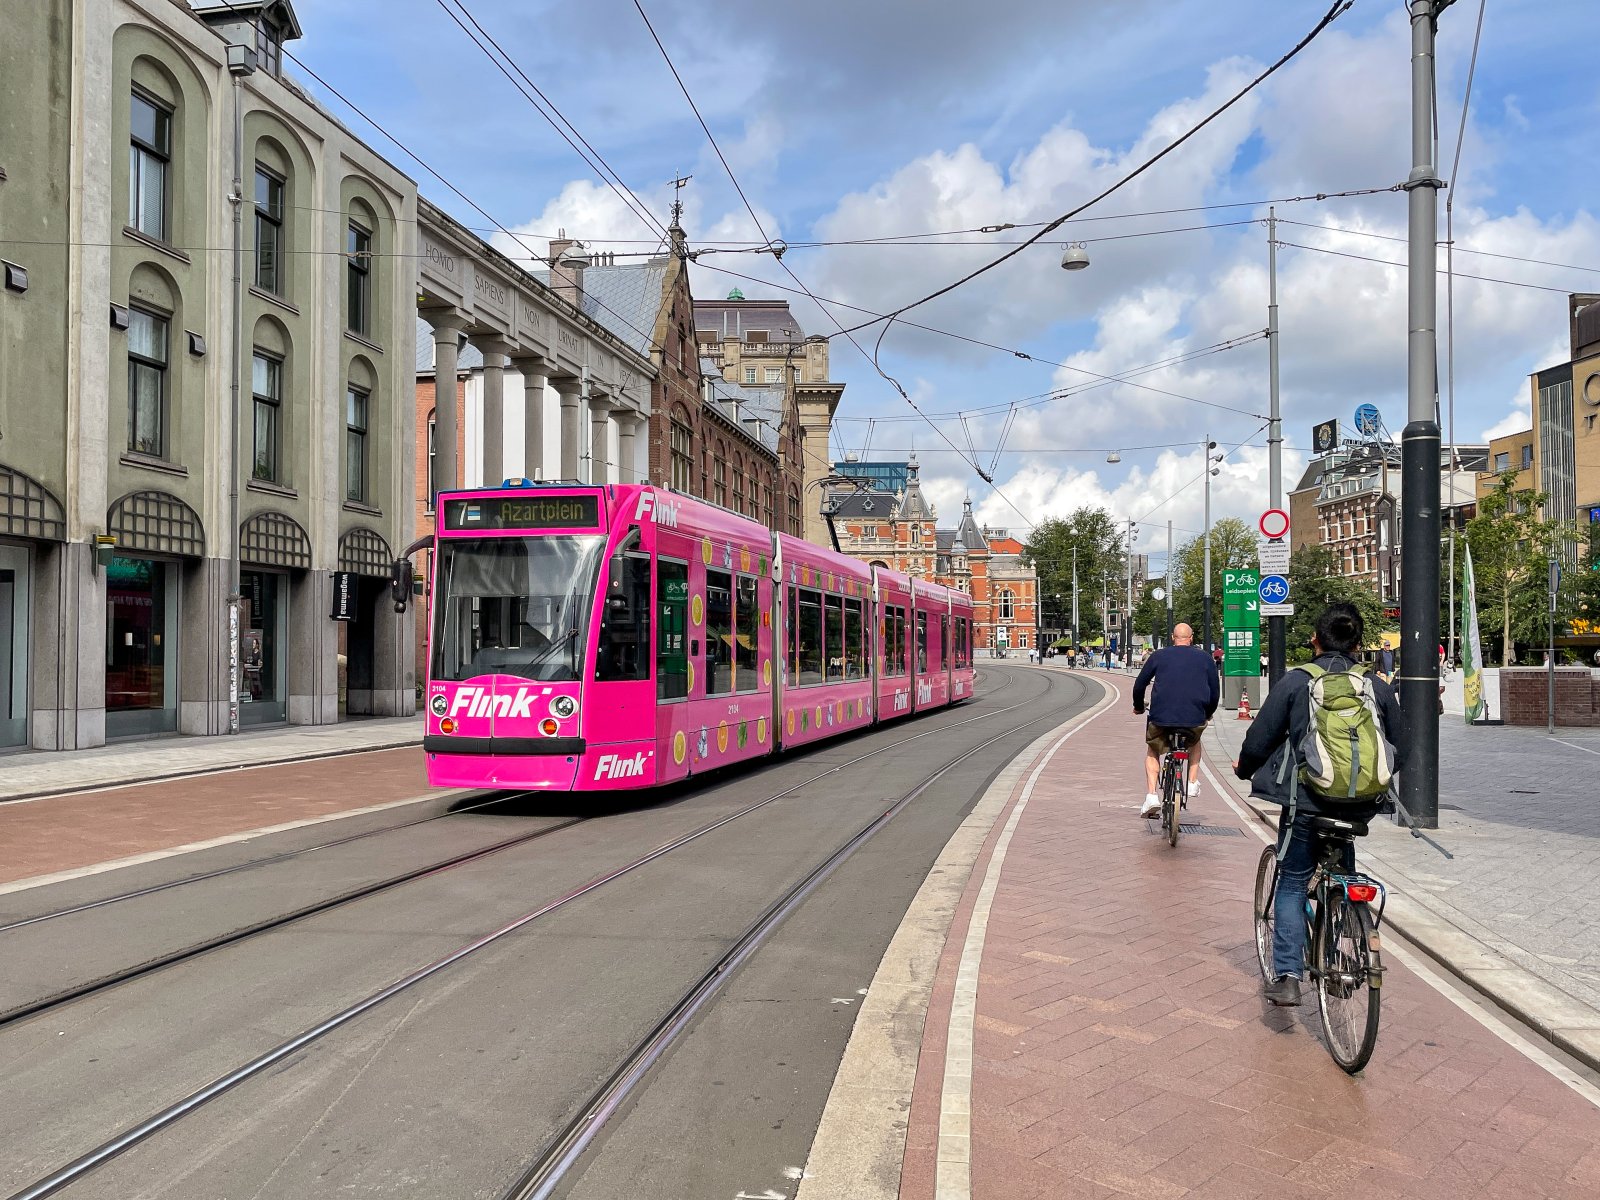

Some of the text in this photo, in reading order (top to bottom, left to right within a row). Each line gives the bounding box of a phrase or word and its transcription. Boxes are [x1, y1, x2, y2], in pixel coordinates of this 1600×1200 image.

[425, 242, 454, 273] HOMO
[474, 274, 504, 305] SAPIENS
[524, 306, 540, 328] NON
[458, 500, 583, 526] 7 Azartplein
[635, 491, 679, 528] Flink
[340, 573, 349, 615] wagamama
[1225, 574, 1235, 587] P
[450, 687, 542, 718] Flink
[594, 752, 649, 781] Flink
